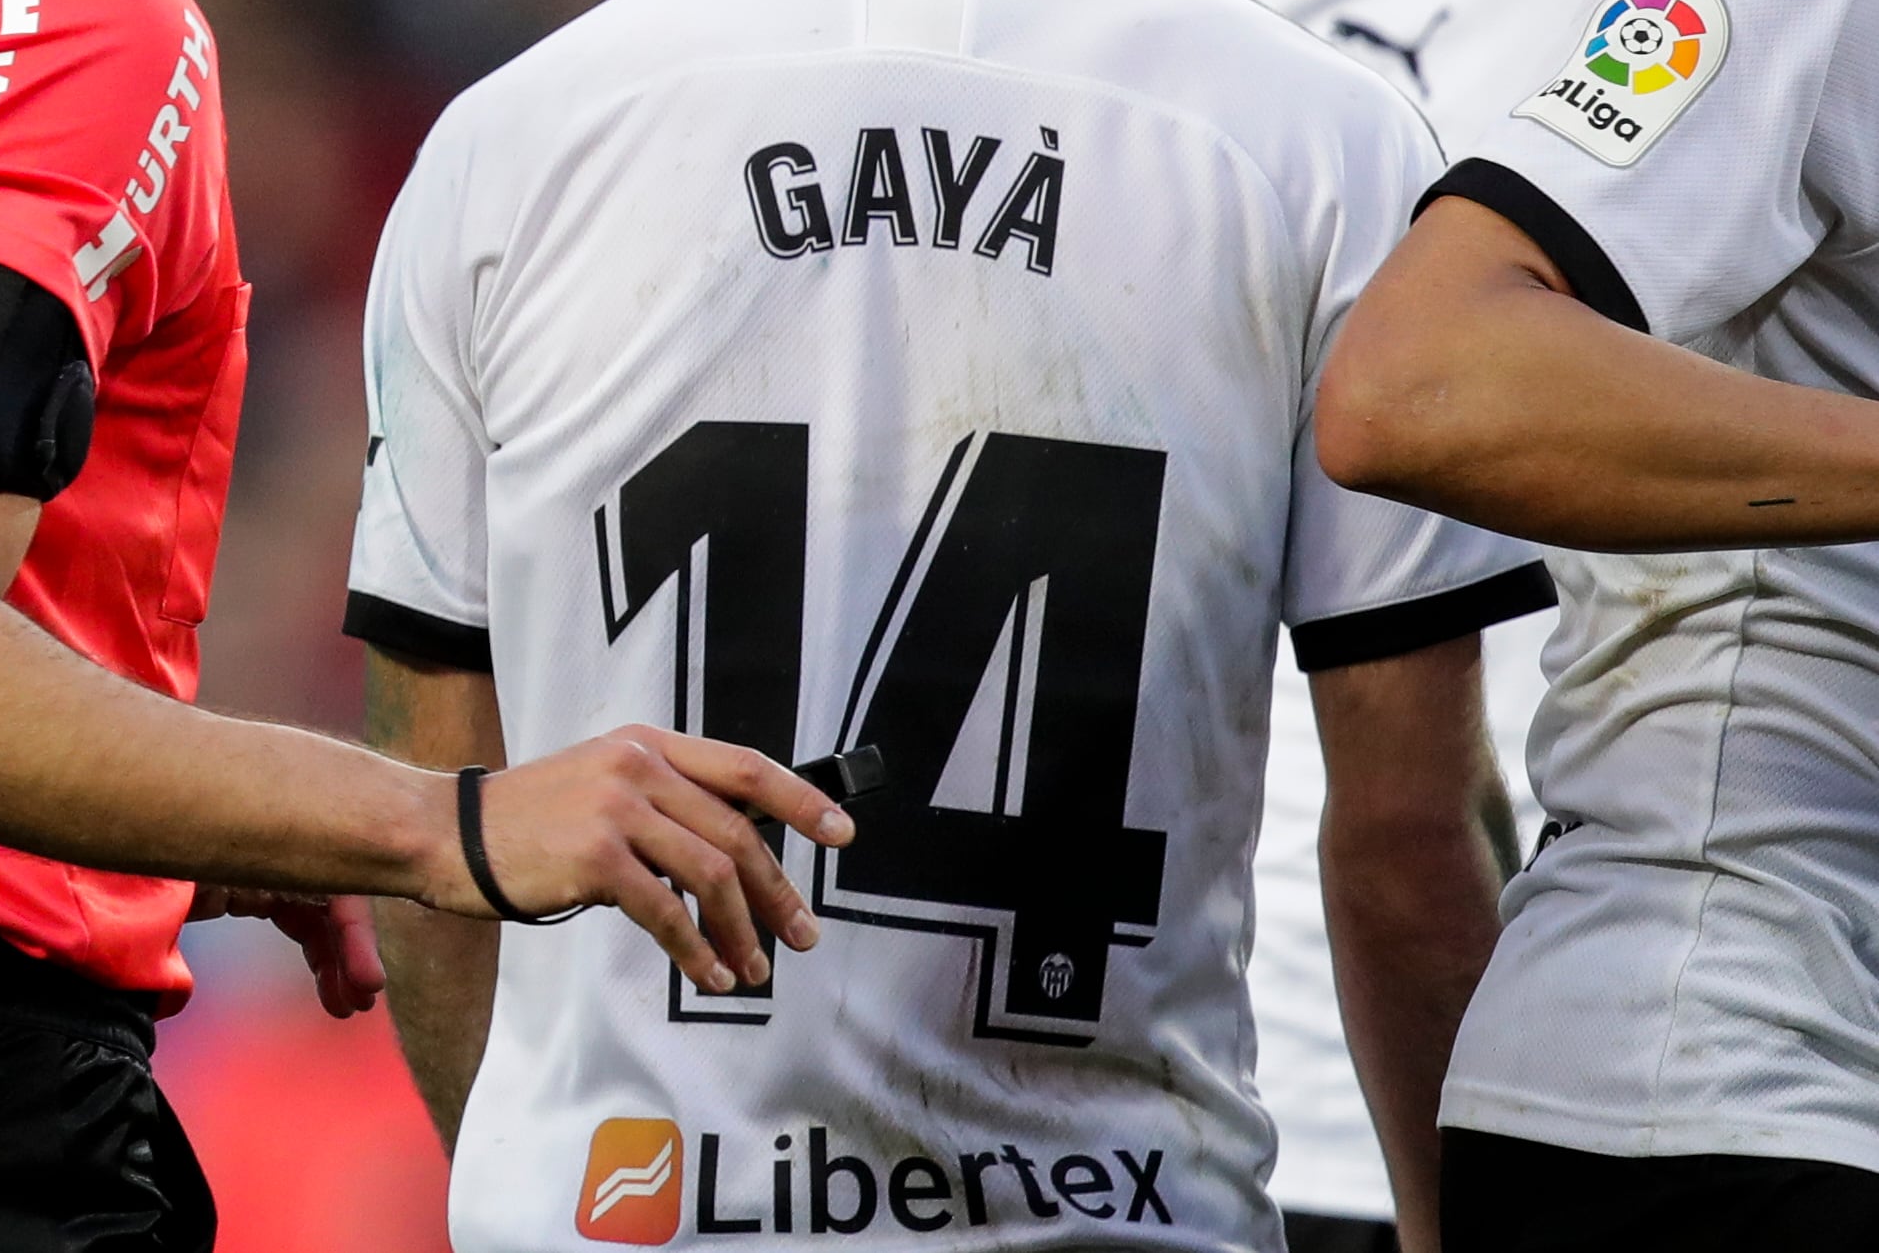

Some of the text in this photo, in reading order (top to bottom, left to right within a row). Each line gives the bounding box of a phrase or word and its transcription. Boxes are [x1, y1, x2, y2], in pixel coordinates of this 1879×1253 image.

[120, 9, 211, 216] ÜRTH
[744, 125, 1065, 277] GAYÀ
[594, 421, 1168, 1048] 14
[696, 1126, 1173, 1234] Libertex
